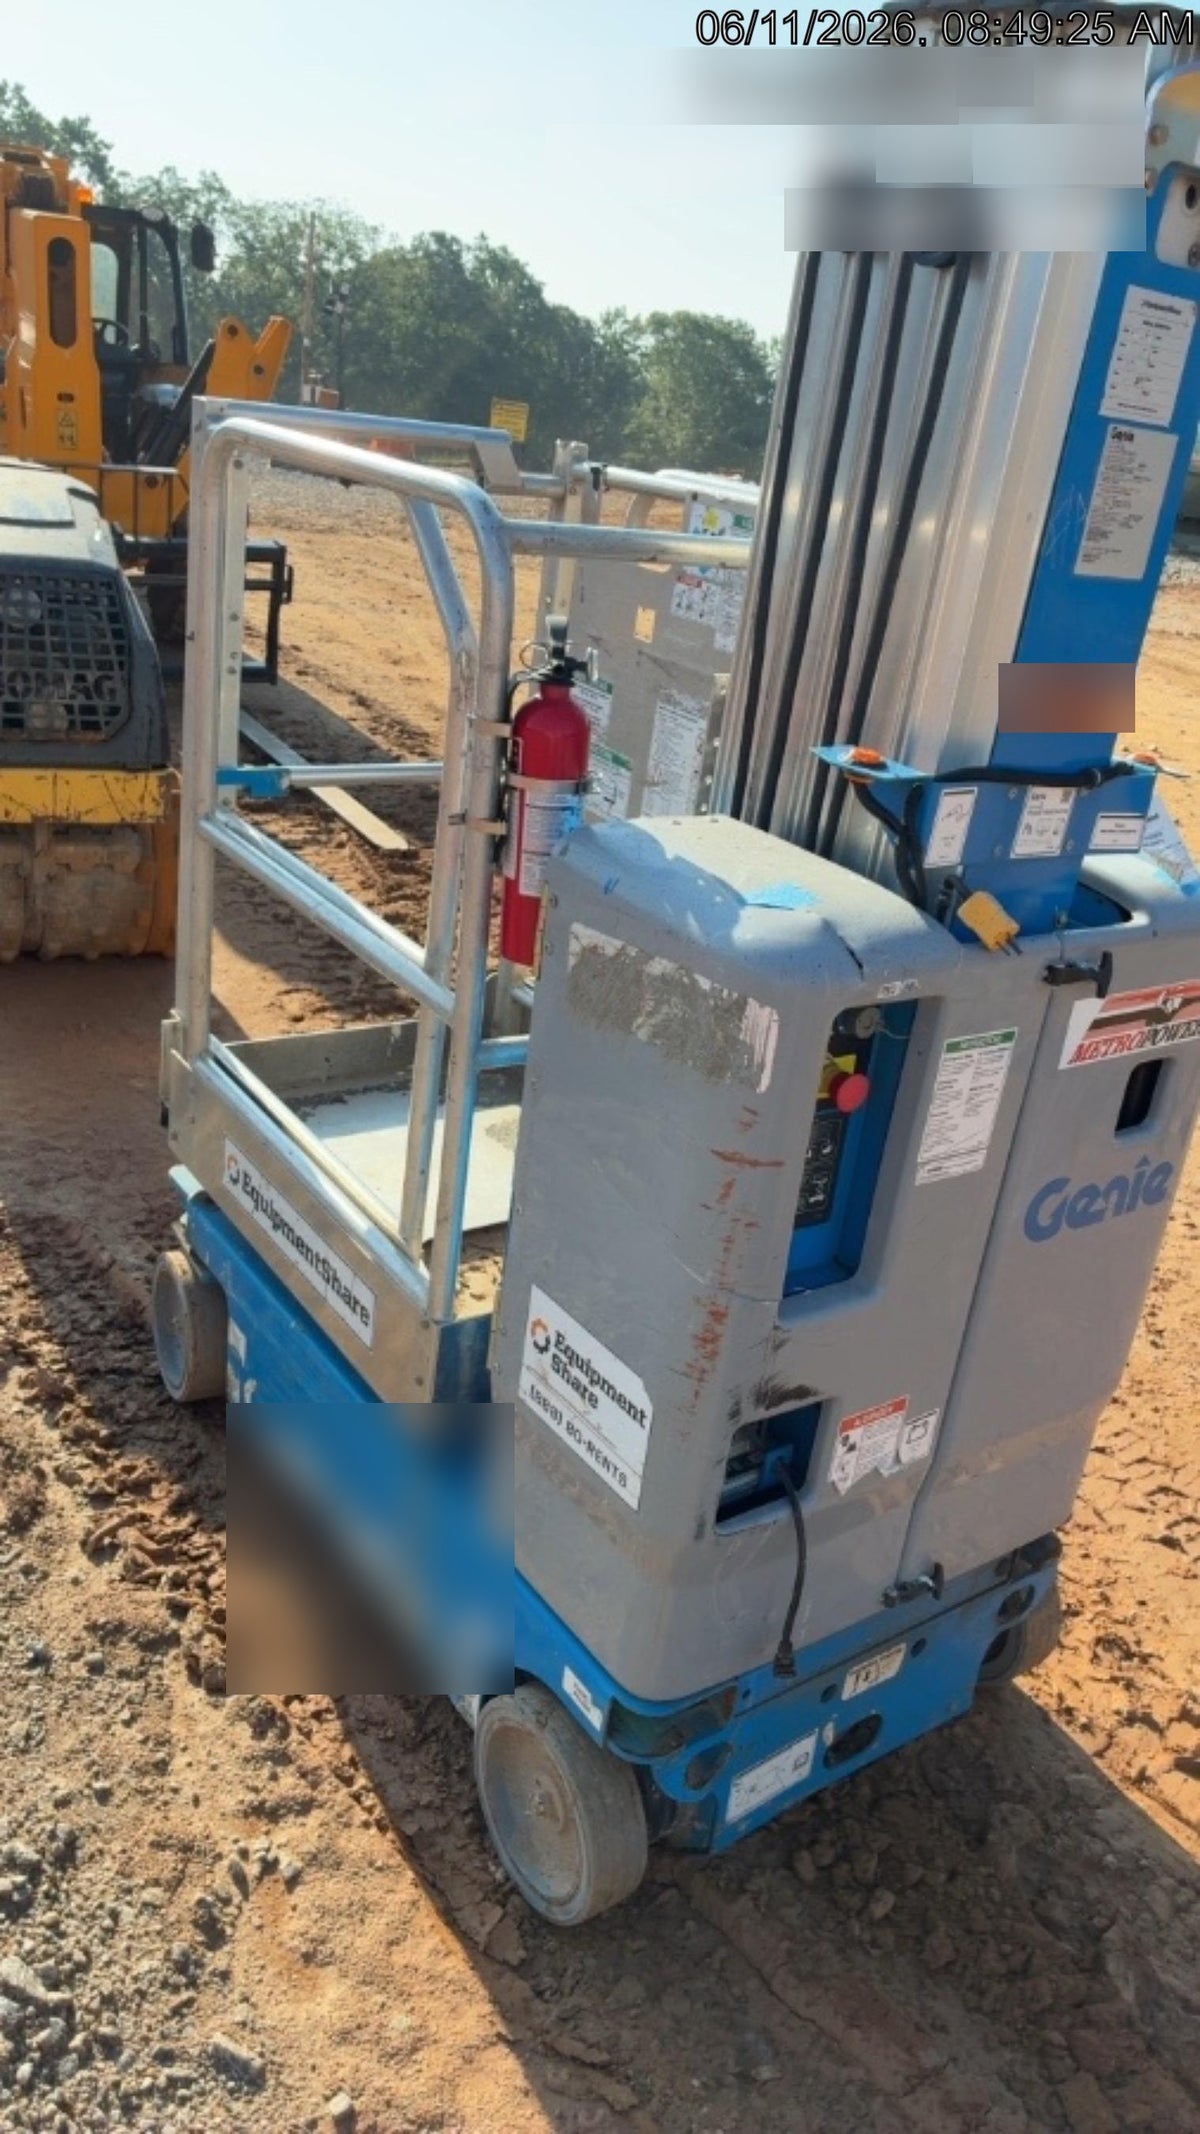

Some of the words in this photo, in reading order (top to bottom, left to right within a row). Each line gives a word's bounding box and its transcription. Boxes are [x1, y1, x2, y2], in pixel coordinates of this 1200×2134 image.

[1024, 1155, 1174, 1243] Genie
[241, 1171, 370, 1327] EquipmentShare
[551, 1352, 599, 1410] Share
[554, 1330, 647, 1429] Equipment
